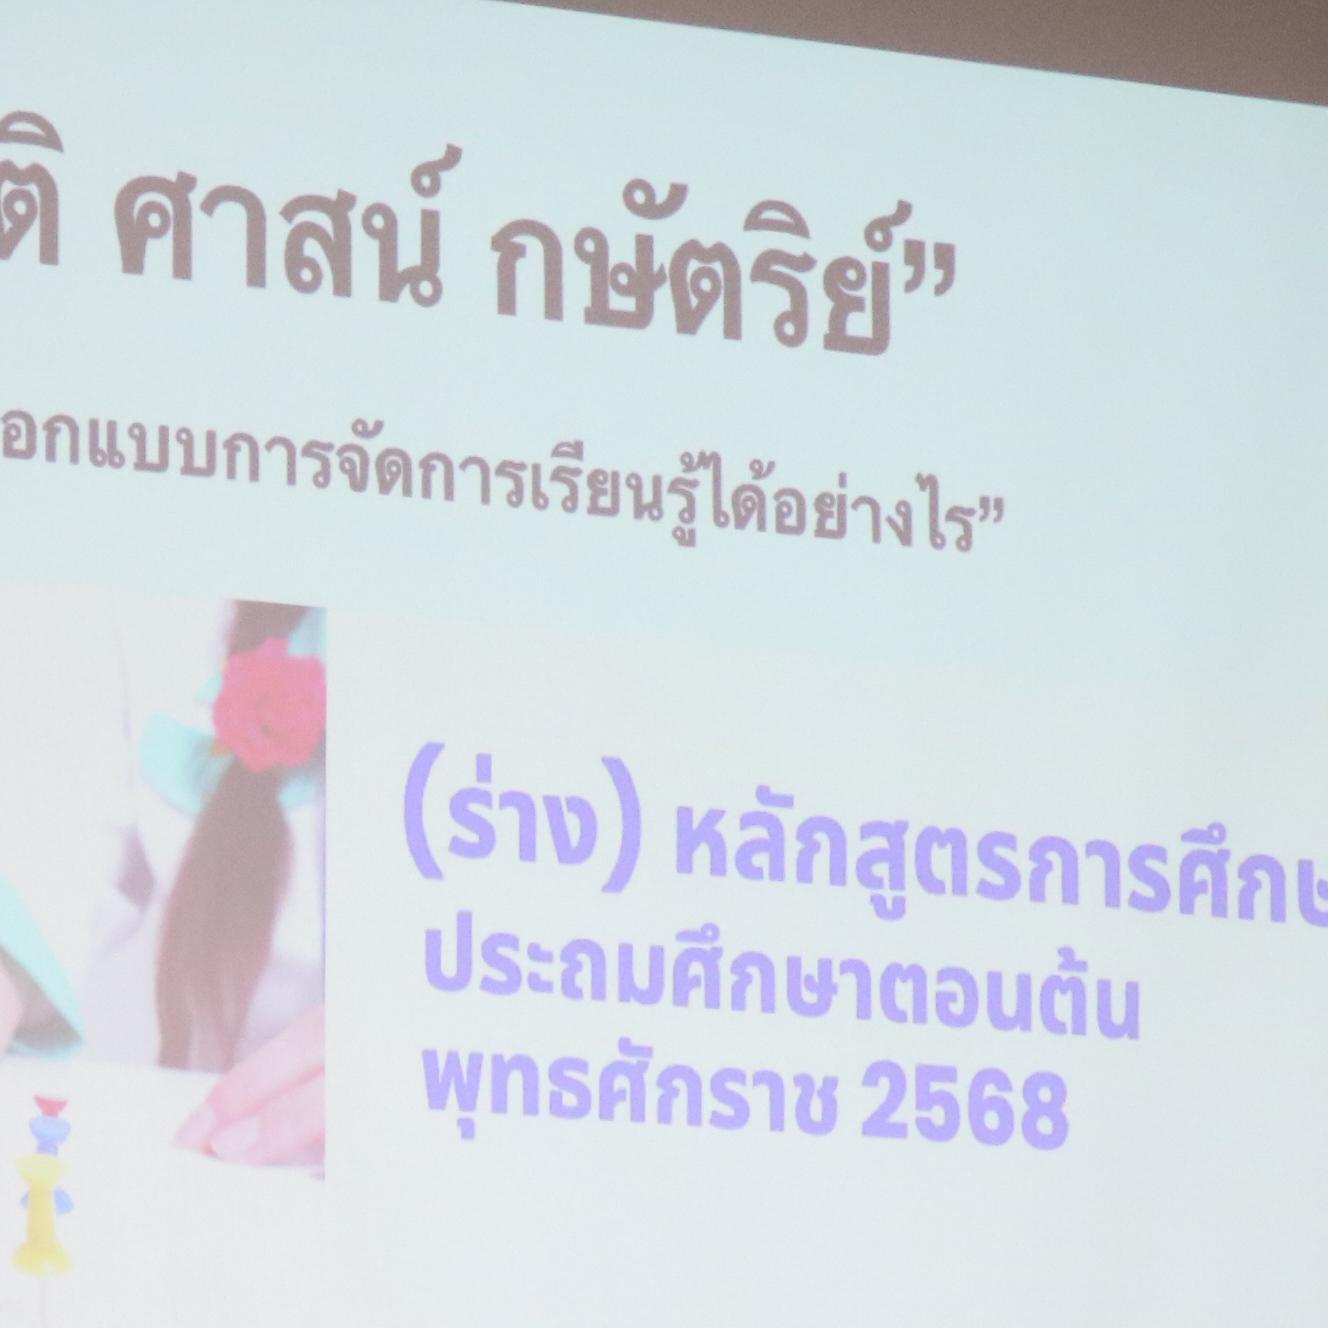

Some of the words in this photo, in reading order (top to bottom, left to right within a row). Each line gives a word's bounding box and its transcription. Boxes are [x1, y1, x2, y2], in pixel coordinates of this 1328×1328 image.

[113, 142, 464, 310] ศาสน์
[489, 177, 958, 358] กษัตริย์”
[402, 739, 644, 895] (ร่าง)
[424, 908, 1142, 1042] ประถมศึกษาตอนต้น
[421, 1035, 841, 1142] พุทธศักราช
[861, 1059, 1071, 1152] 2568
